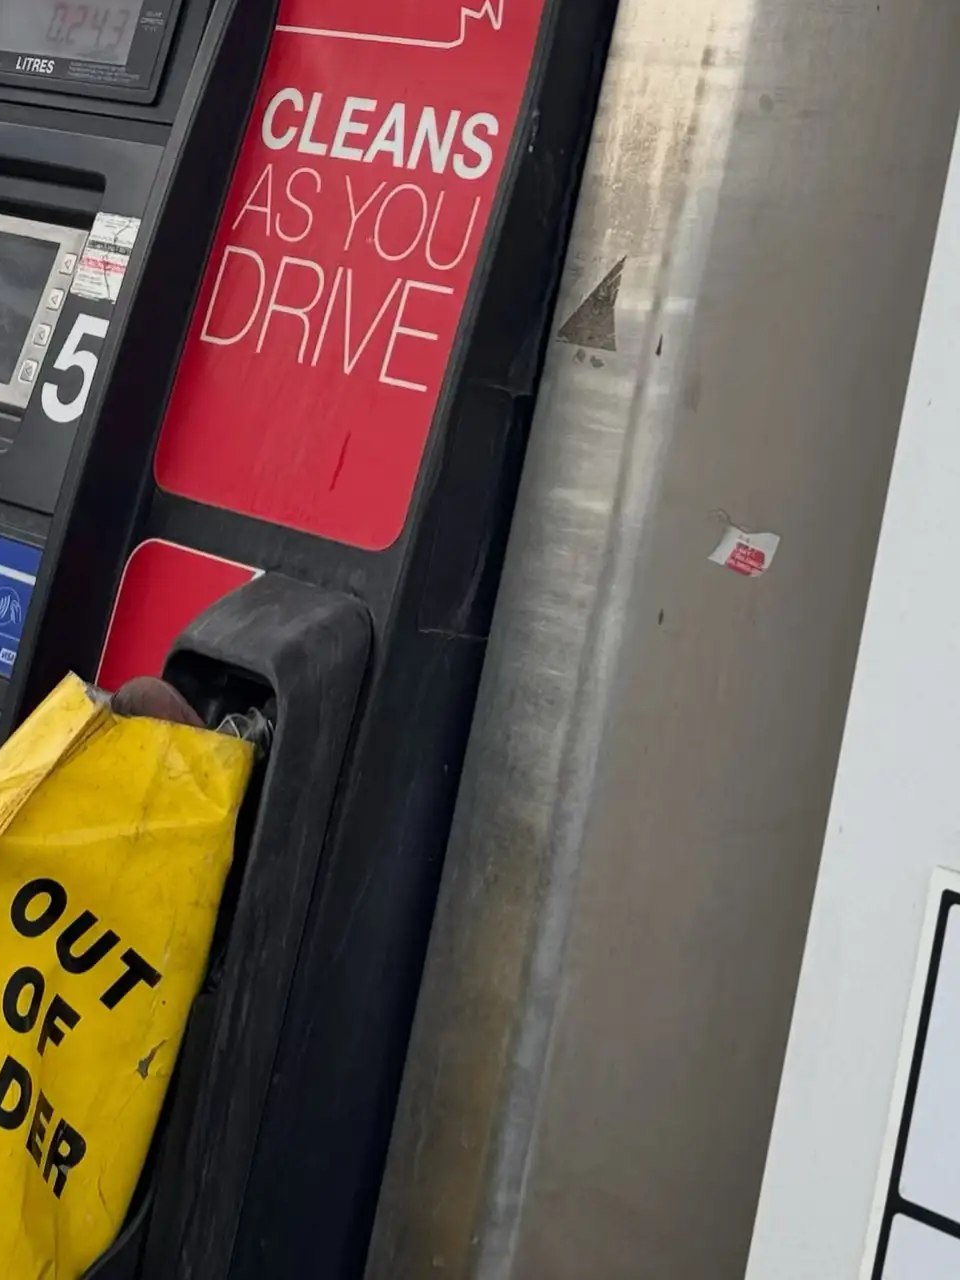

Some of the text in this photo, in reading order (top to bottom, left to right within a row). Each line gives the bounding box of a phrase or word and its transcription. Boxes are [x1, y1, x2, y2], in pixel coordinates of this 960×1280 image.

[15, 56, 55, 74] LITRES
[261, 87, 498, 180] CLEANS
[232, 163, 480, 271] AS YOU
[41, 313, 110, 423] 5
[199, 245, 455, 392] DRIVE
[1, 649, 16, 661] VISA
[10, 877, 161, 1010] OUT
[2, 966, 81, 1057] OF
